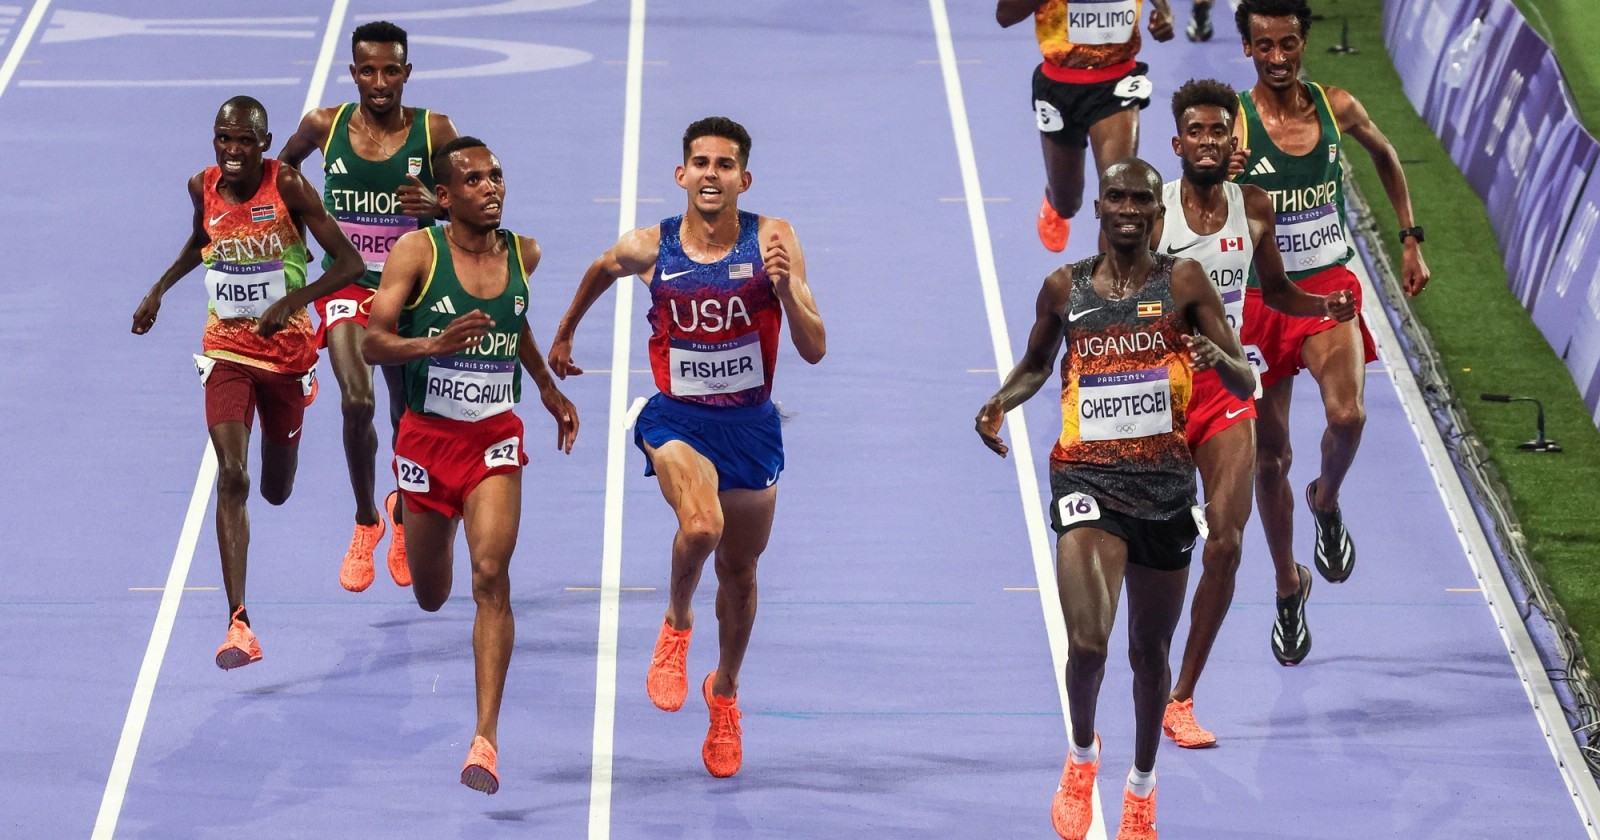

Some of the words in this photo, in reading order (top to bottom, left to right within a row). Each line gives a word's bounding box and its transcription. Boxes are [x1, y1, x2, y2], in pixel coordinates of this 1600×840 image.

[1069, 9, 1136, 28] KIPLIMO
[1128, 80, 1141, 93] 5
[1282, 214, 1303, 223] PARIS
[212, 232, 284, 262] KENYA
[222, 264, 240, 272] PARIS
[241, 264, 261, 272] 2024
[216, 281, 270, 302] KIBET
[329, 303, 350, 317] 12
[670, 296, 752, 333] USA
[692, 342, 715, 350] PARIS
[717, 341, 738, 349] 2024
[1076, 331, 1167, 358] UGANDA
[454, 361, 477, 369] PARIS
[680, 356, 753, 378] FISHER
[1097, 375, 1121, 384] PARIS
[1123, 373, 1145, 381] 2024
[428, 377, 513, 404] AREGAWI
[1081, 391, 1167, 419] CHEPTEGEI
[491, 443, 515, 461] 22
[401, 463, 426, 484] 22
[1064, 498, 1092, 517] 16
